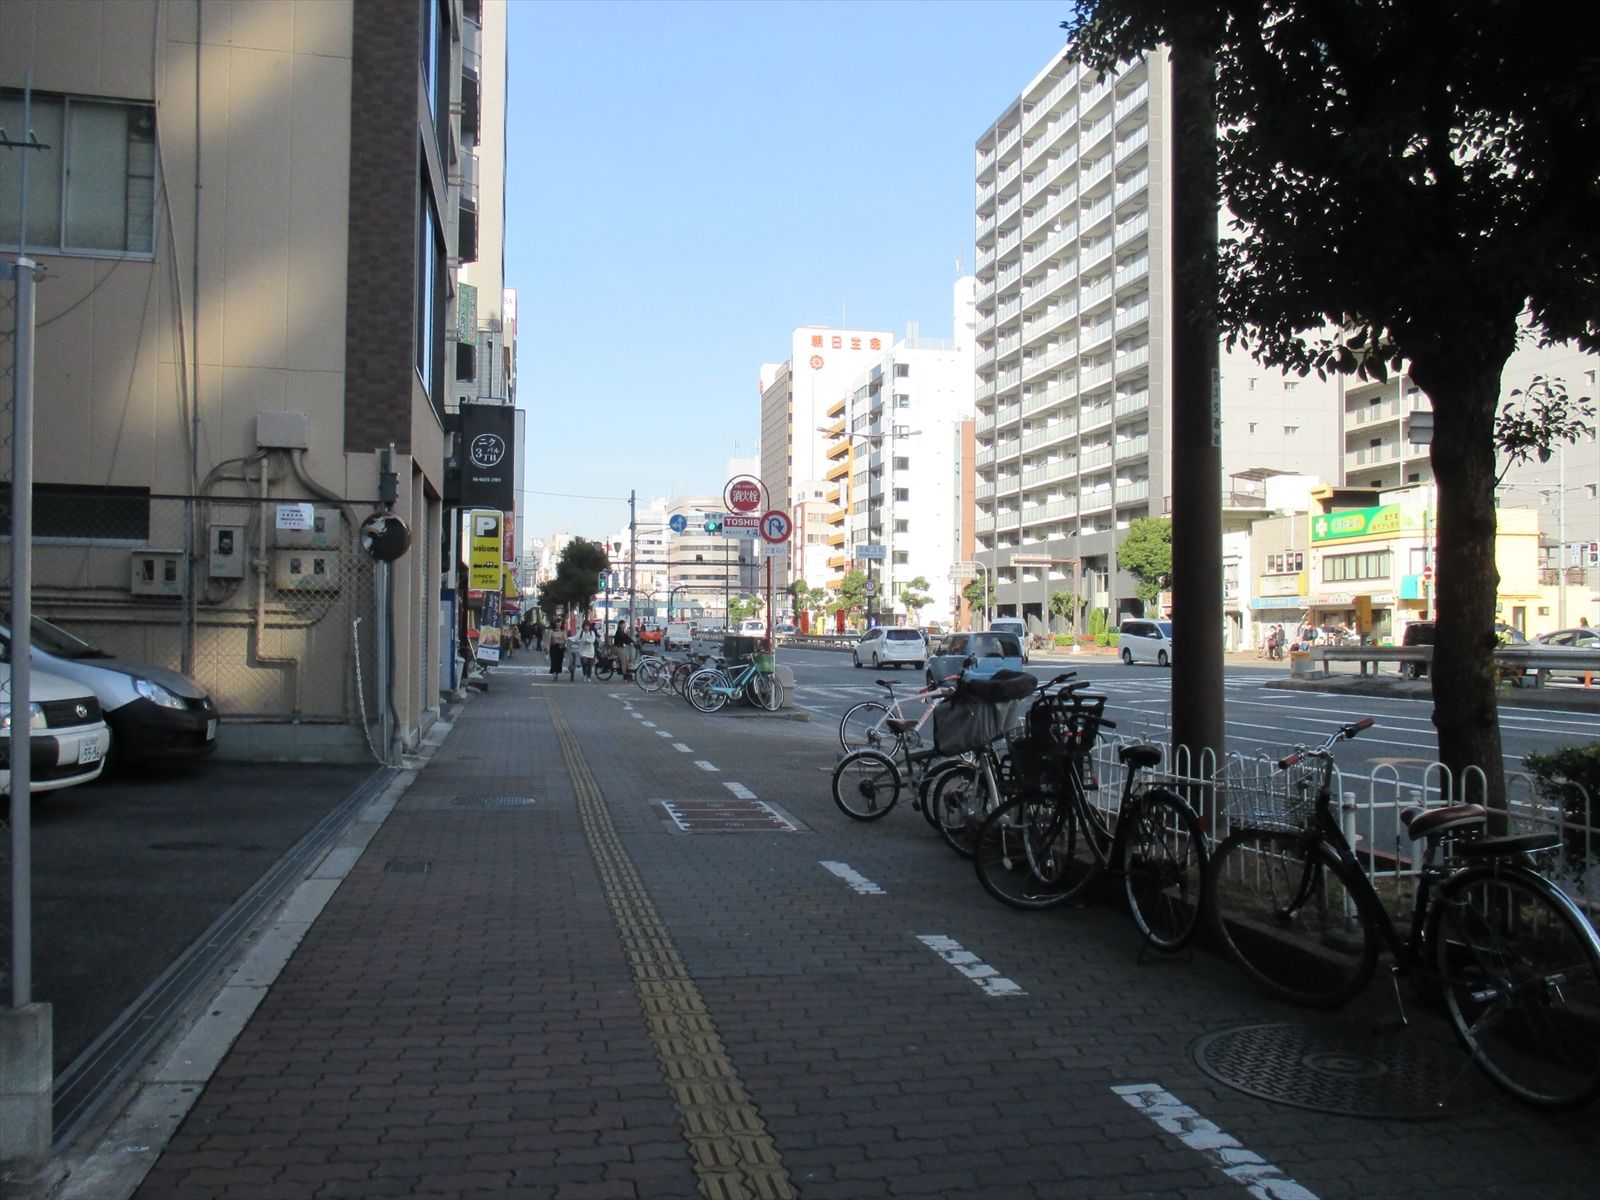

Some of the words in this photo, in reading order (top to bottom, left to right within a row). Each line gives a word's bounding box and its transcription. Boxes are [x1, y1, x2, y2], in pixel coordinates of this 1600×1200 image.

[811, 335, 881, 350] 朝日生命
[478, 437, 496, 447] ニク
[733, 490, 758, 502] 消火栓
[476, 516, 497, 536] P
[726, 518, 760, 526] TOSHIB
[473, 545, 499, 553] welcome
